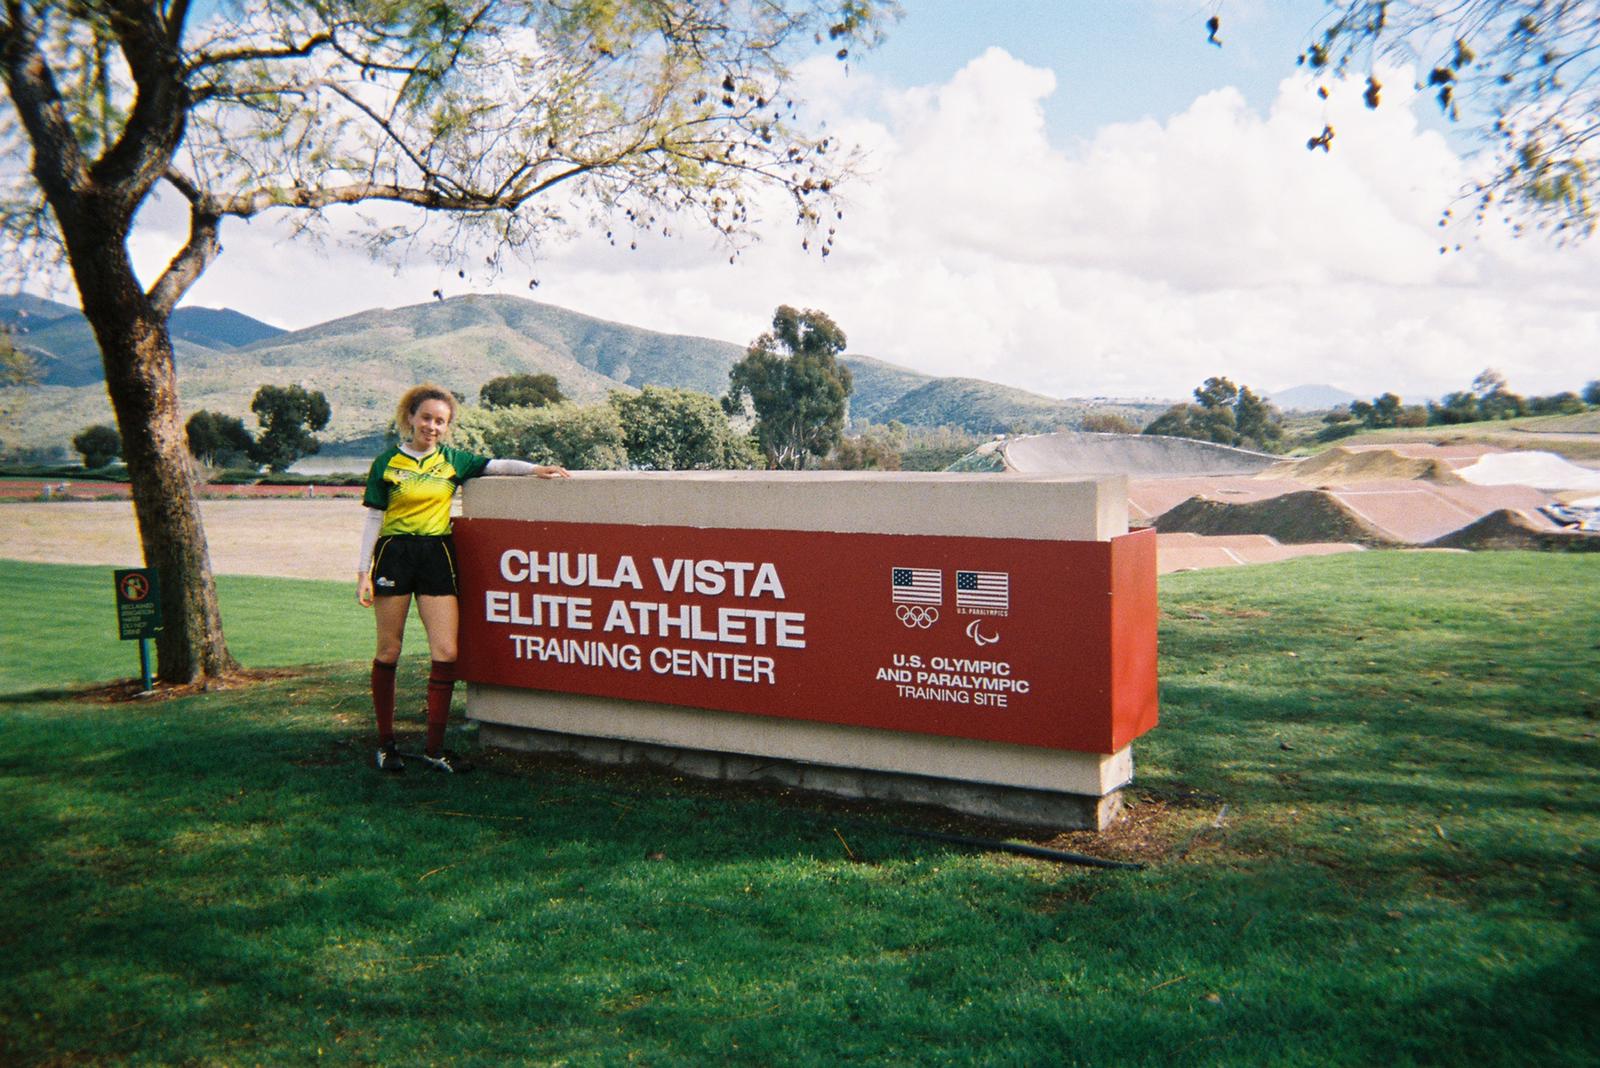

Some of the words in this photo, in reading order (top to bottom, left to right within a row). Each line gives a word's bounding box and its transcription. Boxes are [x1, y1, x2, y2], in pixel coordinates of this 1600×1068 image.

[500, 549, 643, 590] CHULA
[652, 557, 785, 599] VISTA
[486, 590, 592, 630] ELITE
[603, 599, 806, 649] ATHLETE
[969, 608, 1008, 617] PARALYMPICS
[509, 634, 641, 671] TRAINING
[650, 647, 775, 684] CENTER
[893, 654, 925, 668] U.S.
[931, 657, 1010, 676] OLYMPIC
[876, 668, 912, 682] AND
[917, 671, 1030, 693] PARALYMPIC
[896, 685, 969, 704] TRAINING
[974, 693, 1008, 707] SITE
